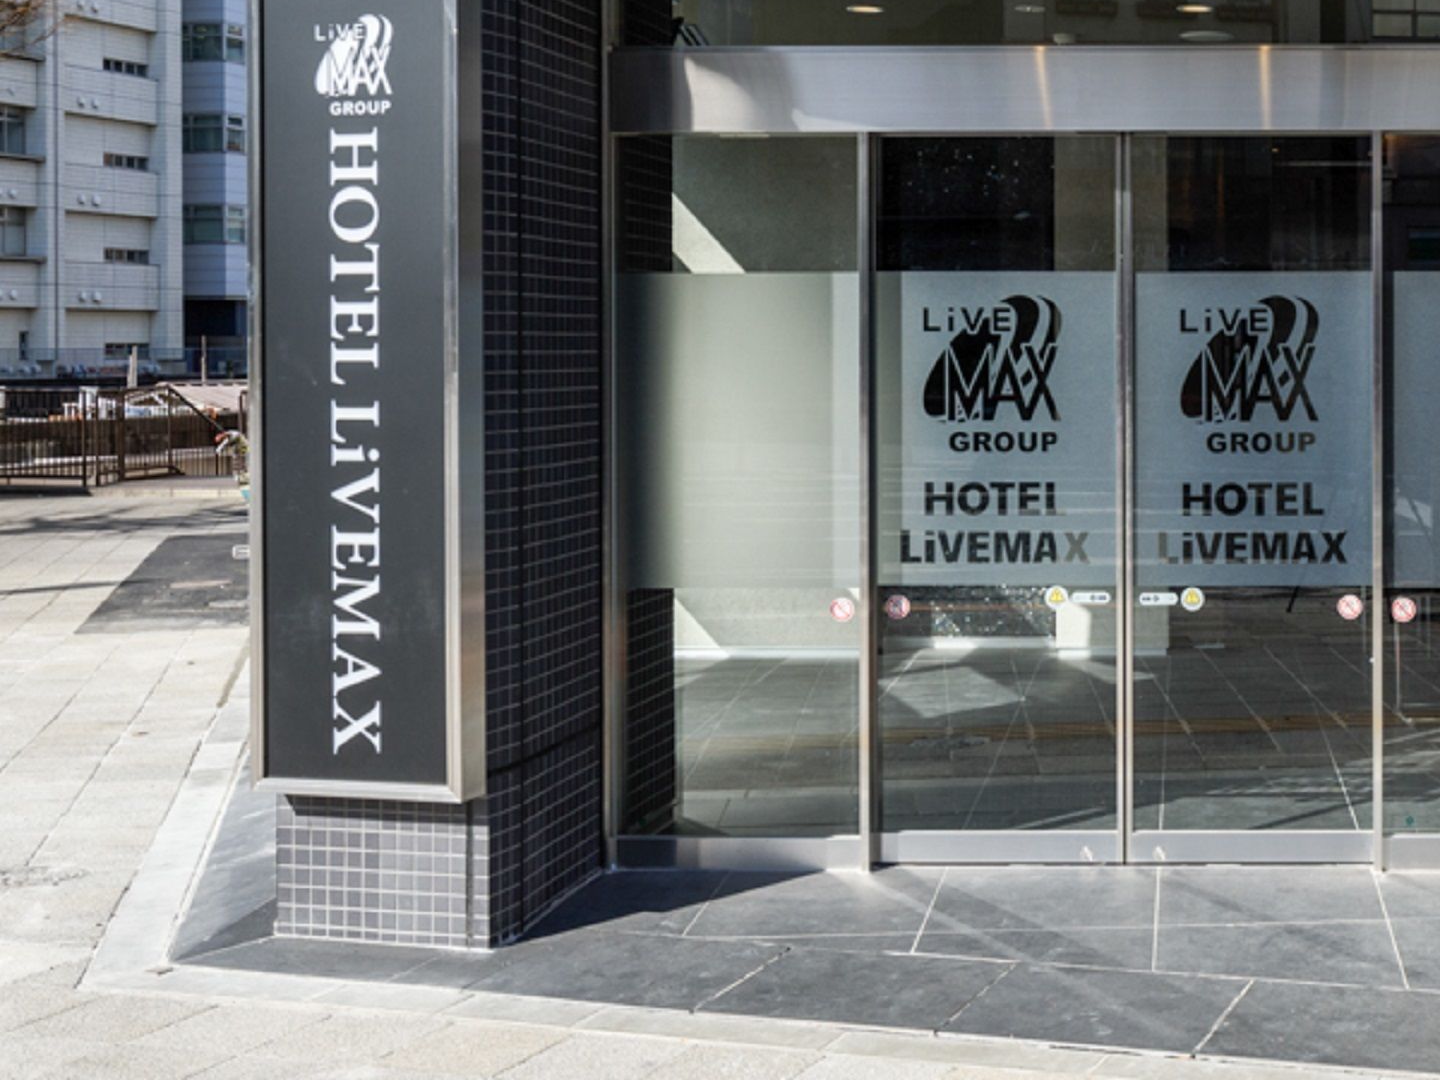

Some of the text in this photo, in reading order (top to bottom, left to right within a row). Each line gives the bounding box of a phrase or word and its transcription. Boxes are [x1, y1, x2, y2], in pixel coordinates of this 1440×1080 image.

[313, 22, 366, 42] LiVE
[329, 100, 392, 116] GROUP
[922, 306, 1012, 333] LiVE
[1179, 307, 1269, 334] LiVE
[946, 343, 1062, 422] MAX
[1203, 343, 1320, 422] MAX
[328, 126, 383, 755] HOTEL LiVEMAX
[948, 431, 1058, 453] GROUP
[1206, 431, 1317, 453] GROUP
[924, 480, 1066, 517] HOTEL
[1181, 481, 1325, 517] HOTEL
[900, 529, 1090, 565] LiVEMAX
[1157, 529, 1348, 565] LiVEMAX
